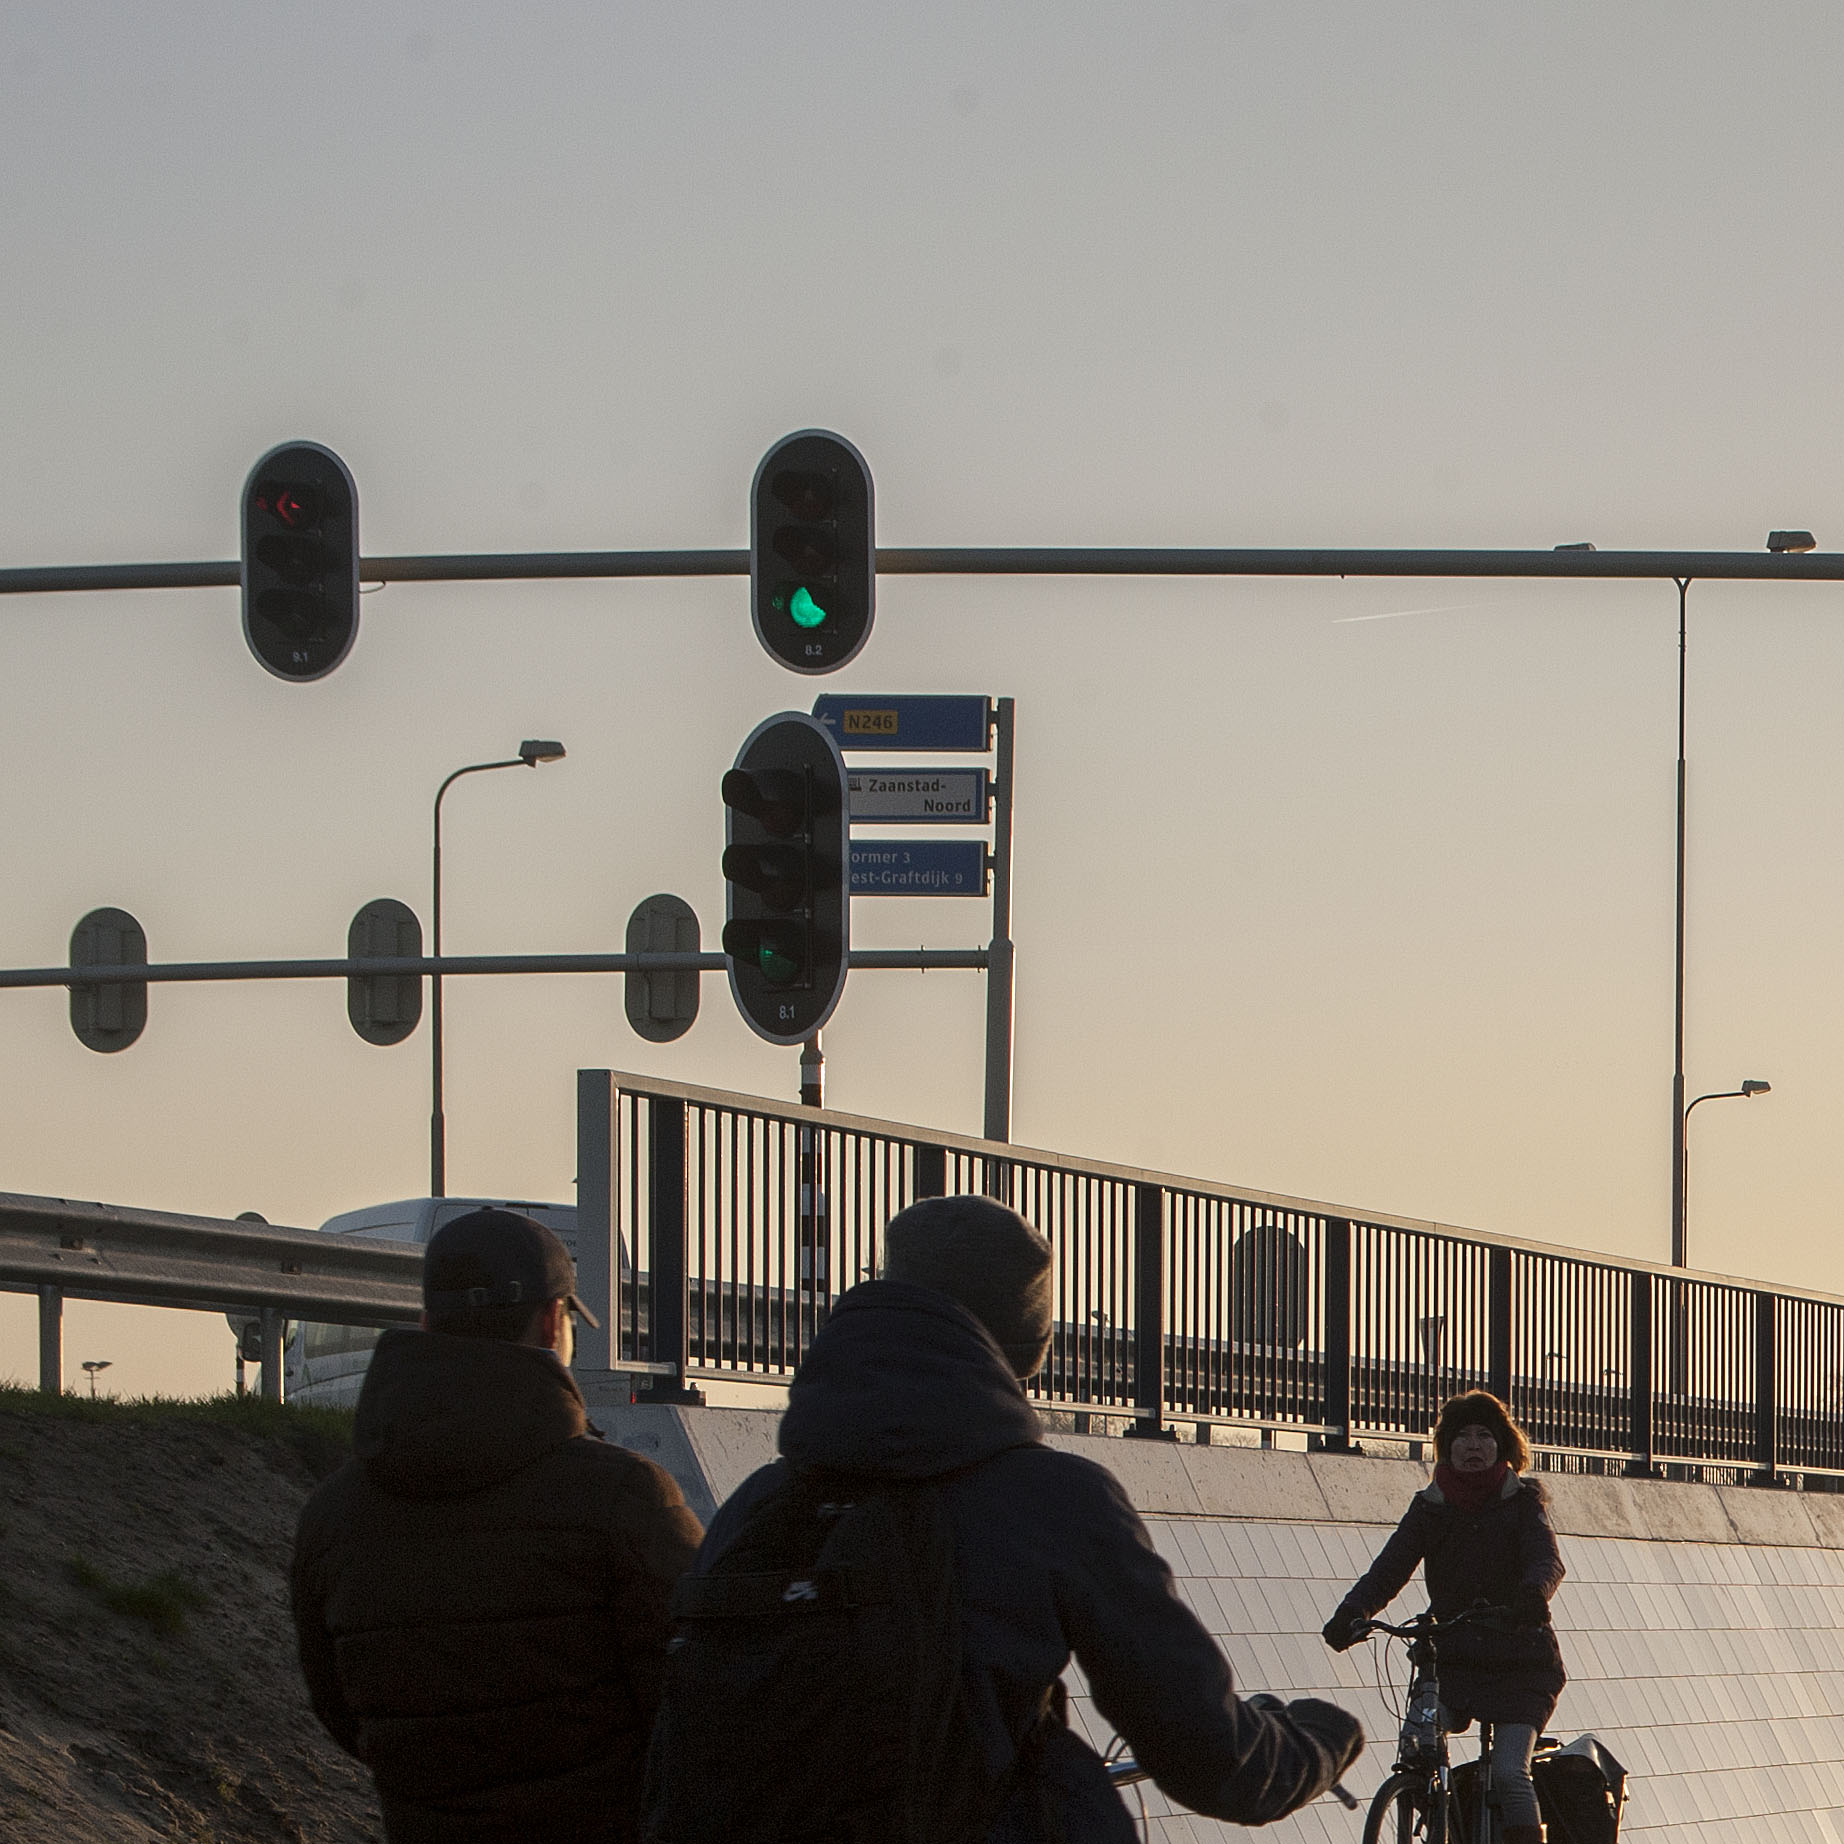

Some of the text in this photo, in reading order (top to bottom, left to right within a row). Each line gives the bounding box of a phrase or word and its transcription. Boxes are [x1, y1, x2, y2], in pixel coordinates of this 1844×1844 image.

[805, 644, 823, 656] 8.2
[849, 714, 893, 730] N246
[868, 778, 947, 793] Zaanstad-
[923, 799, 971, 813] Noord
[849, 851, 911, 864] ormer 3
[848, 871, 963, 887] est-Graftdijk 9
[779, 1004, 795, 1020] 8.1
